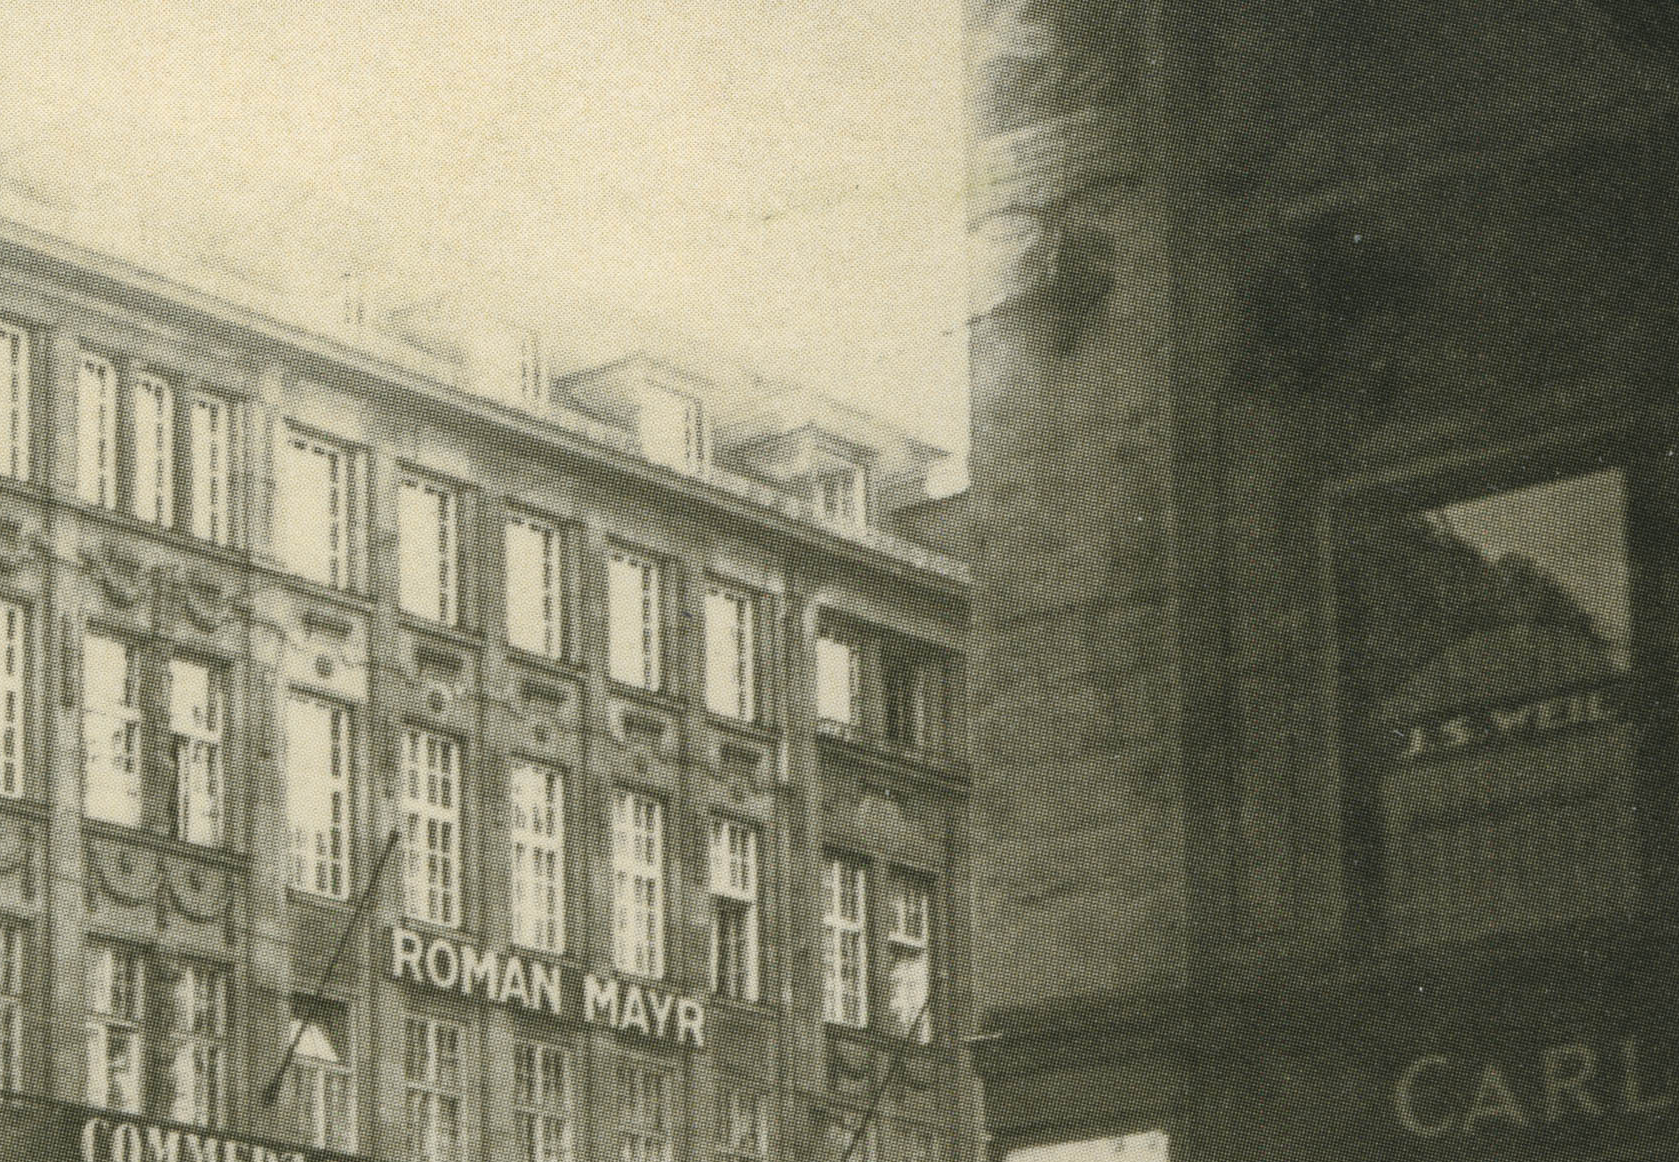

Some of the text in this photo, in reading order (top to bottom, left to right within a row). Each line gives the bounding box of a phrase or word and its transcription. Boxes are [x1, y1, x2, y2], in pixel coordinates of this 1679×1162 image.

[391, 926, 706, 1048] ROMAN MAYR
[1393, 1033, 1675, 1139] CARL
